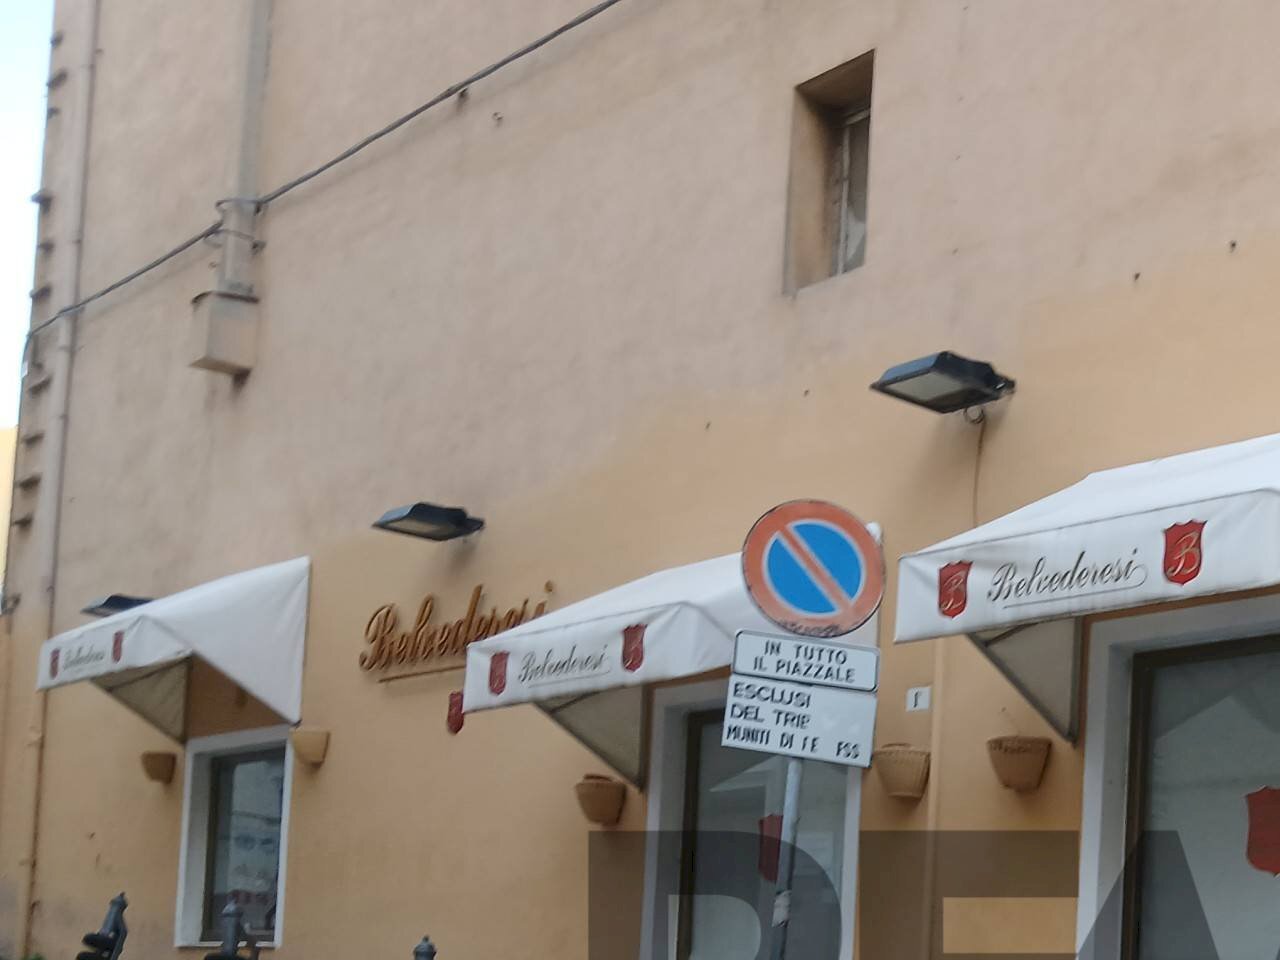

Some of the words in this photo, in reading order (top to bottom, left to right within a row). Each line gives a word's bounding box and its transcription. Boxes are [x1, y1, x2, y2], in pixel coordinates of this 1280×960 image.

[987, 548, 1145, 603] Belvederesi
[764, 640, 781, 655] IN
[794, 644, 848, 665] TUTTO
[753, 656, 767, 671] IL
[775, 659, 856, 683] PIAZZALE
[733, 682, 811, 708] ESCLUSI
[730, 703, 764, 722] DEL
[726, 725, 771, 745] MUNITI
[779, 732, 794, 749] DI
